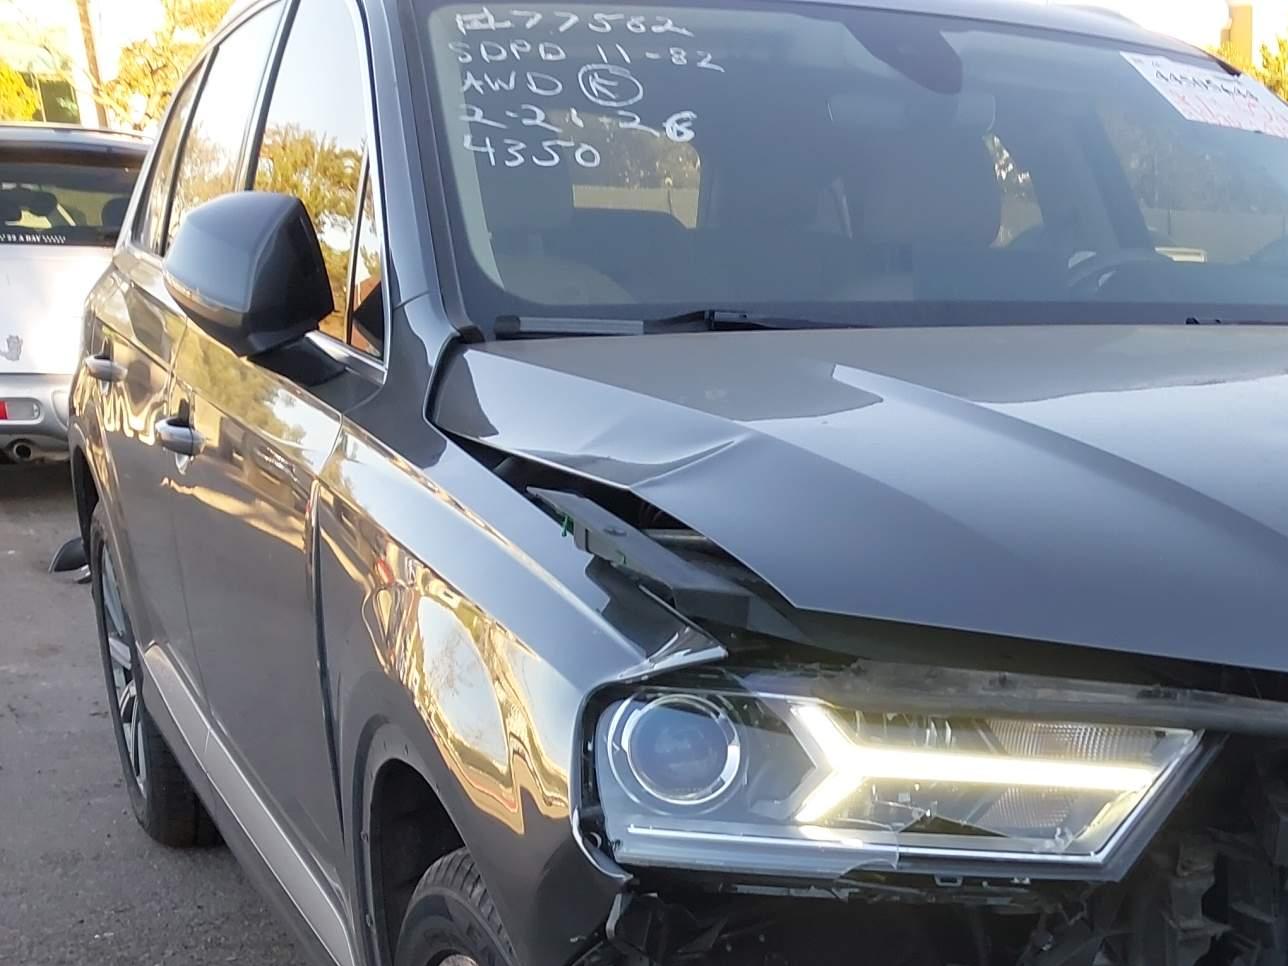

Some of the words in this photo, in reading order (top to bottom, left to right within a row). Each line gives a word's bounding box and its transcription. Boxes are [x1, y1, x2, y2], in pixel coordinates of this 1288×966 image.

[448, 39, 566, 63] SDPD
[597, 43, 725, 72] 11-82
[461, 70, 563, 96] AWD
[463, 134, 601, 167] 4350
